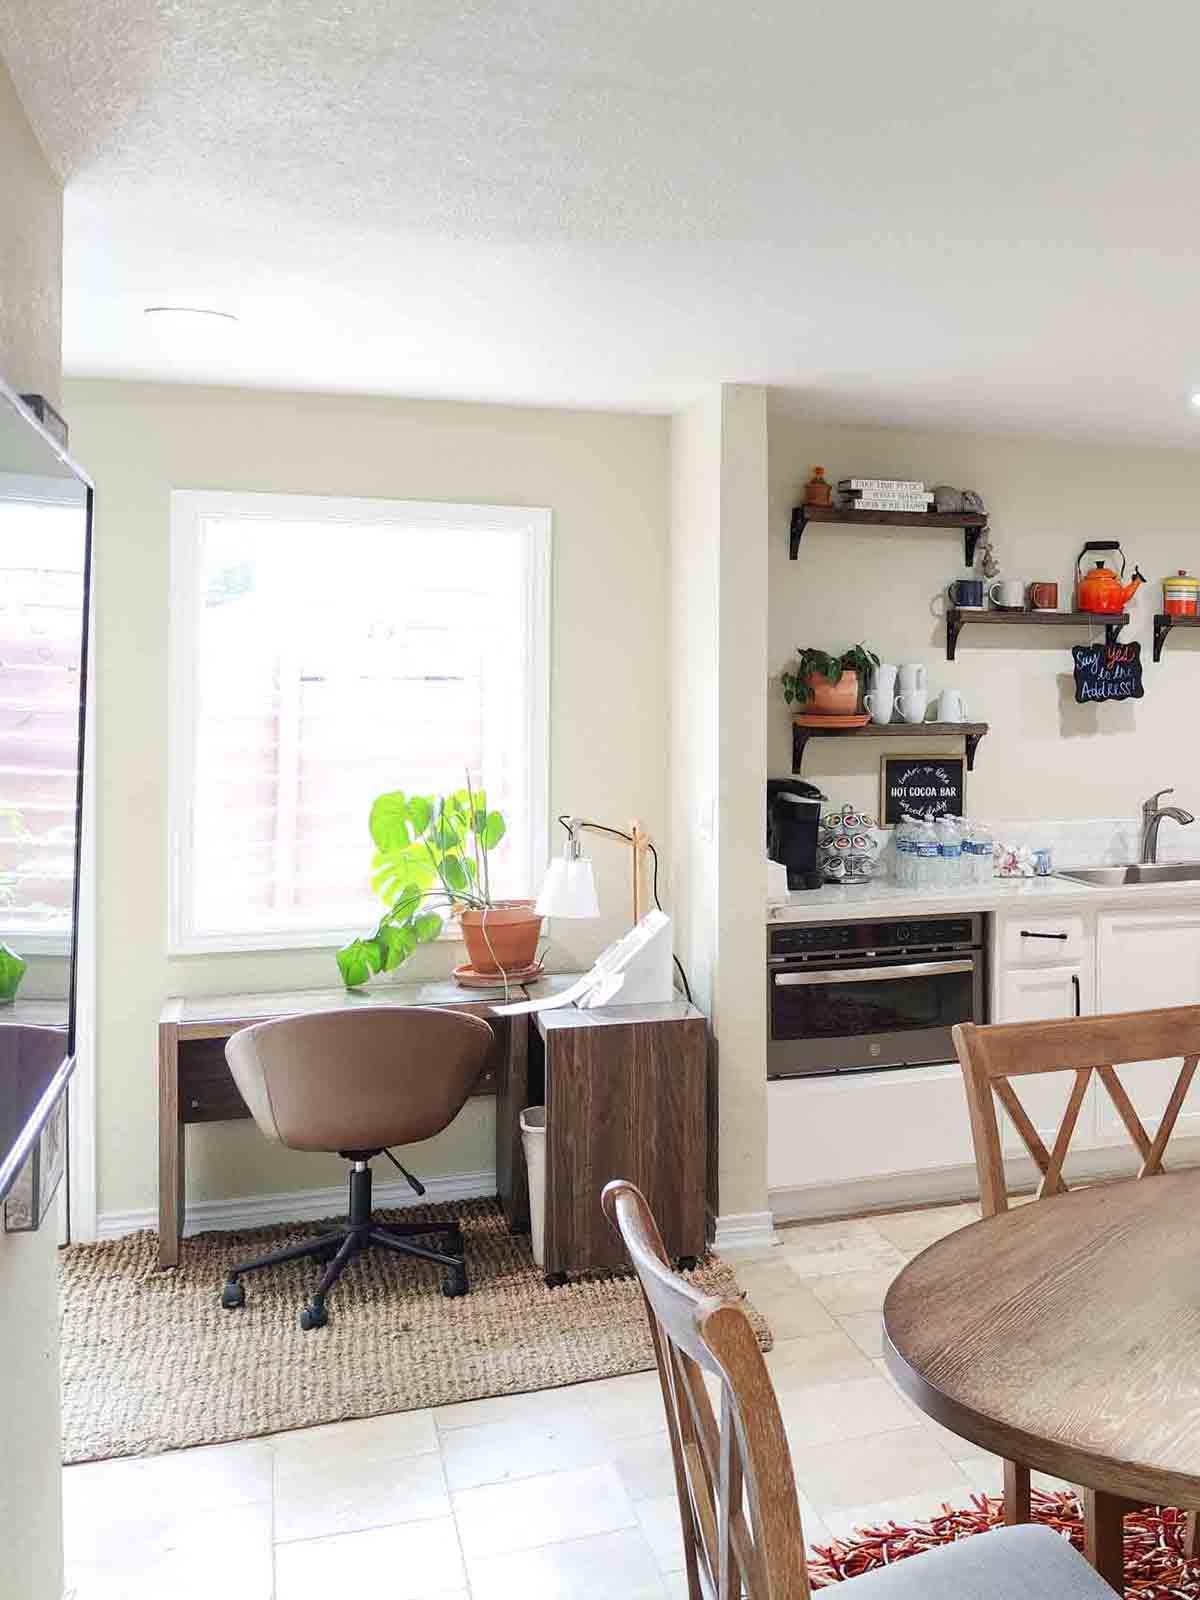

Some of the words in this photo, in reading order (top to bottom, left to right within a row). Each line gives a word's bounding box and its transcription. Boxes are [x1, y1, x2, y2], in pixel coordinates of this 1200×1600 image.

[1076, 650, 1099, 674] Say
[1097, 667, 1111, 680] to
[1113, 663, 1133, 679] the
[891, 786, 907, 798] HOT
[909, 786, 937, 798] COCOA
[940, 786, 957, 797] BAR
